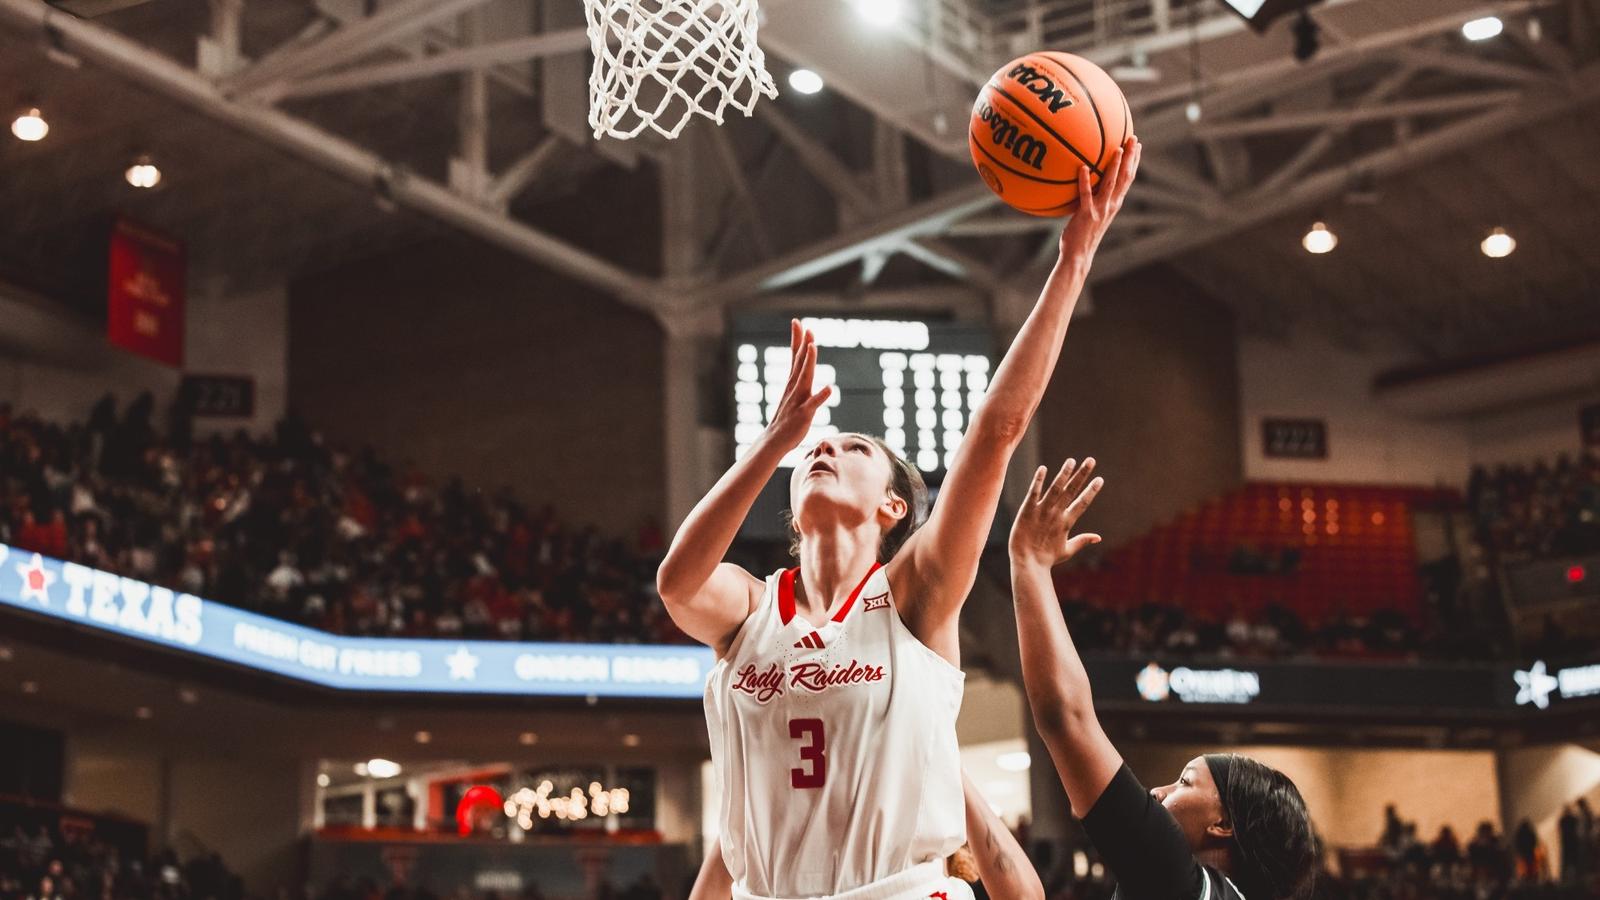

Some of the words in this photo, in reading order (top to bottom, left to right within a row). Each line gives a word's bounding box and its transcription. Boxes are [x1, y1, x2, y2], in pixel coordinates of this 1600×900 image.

[1008, 63, 1072, 115] NCAA
[62, 561, 203, 645] TEXAS
[731, 662, 786, 703] Lady
[789, 659, 887, 692] Raiders
[788, 718, 826, 789] 3
